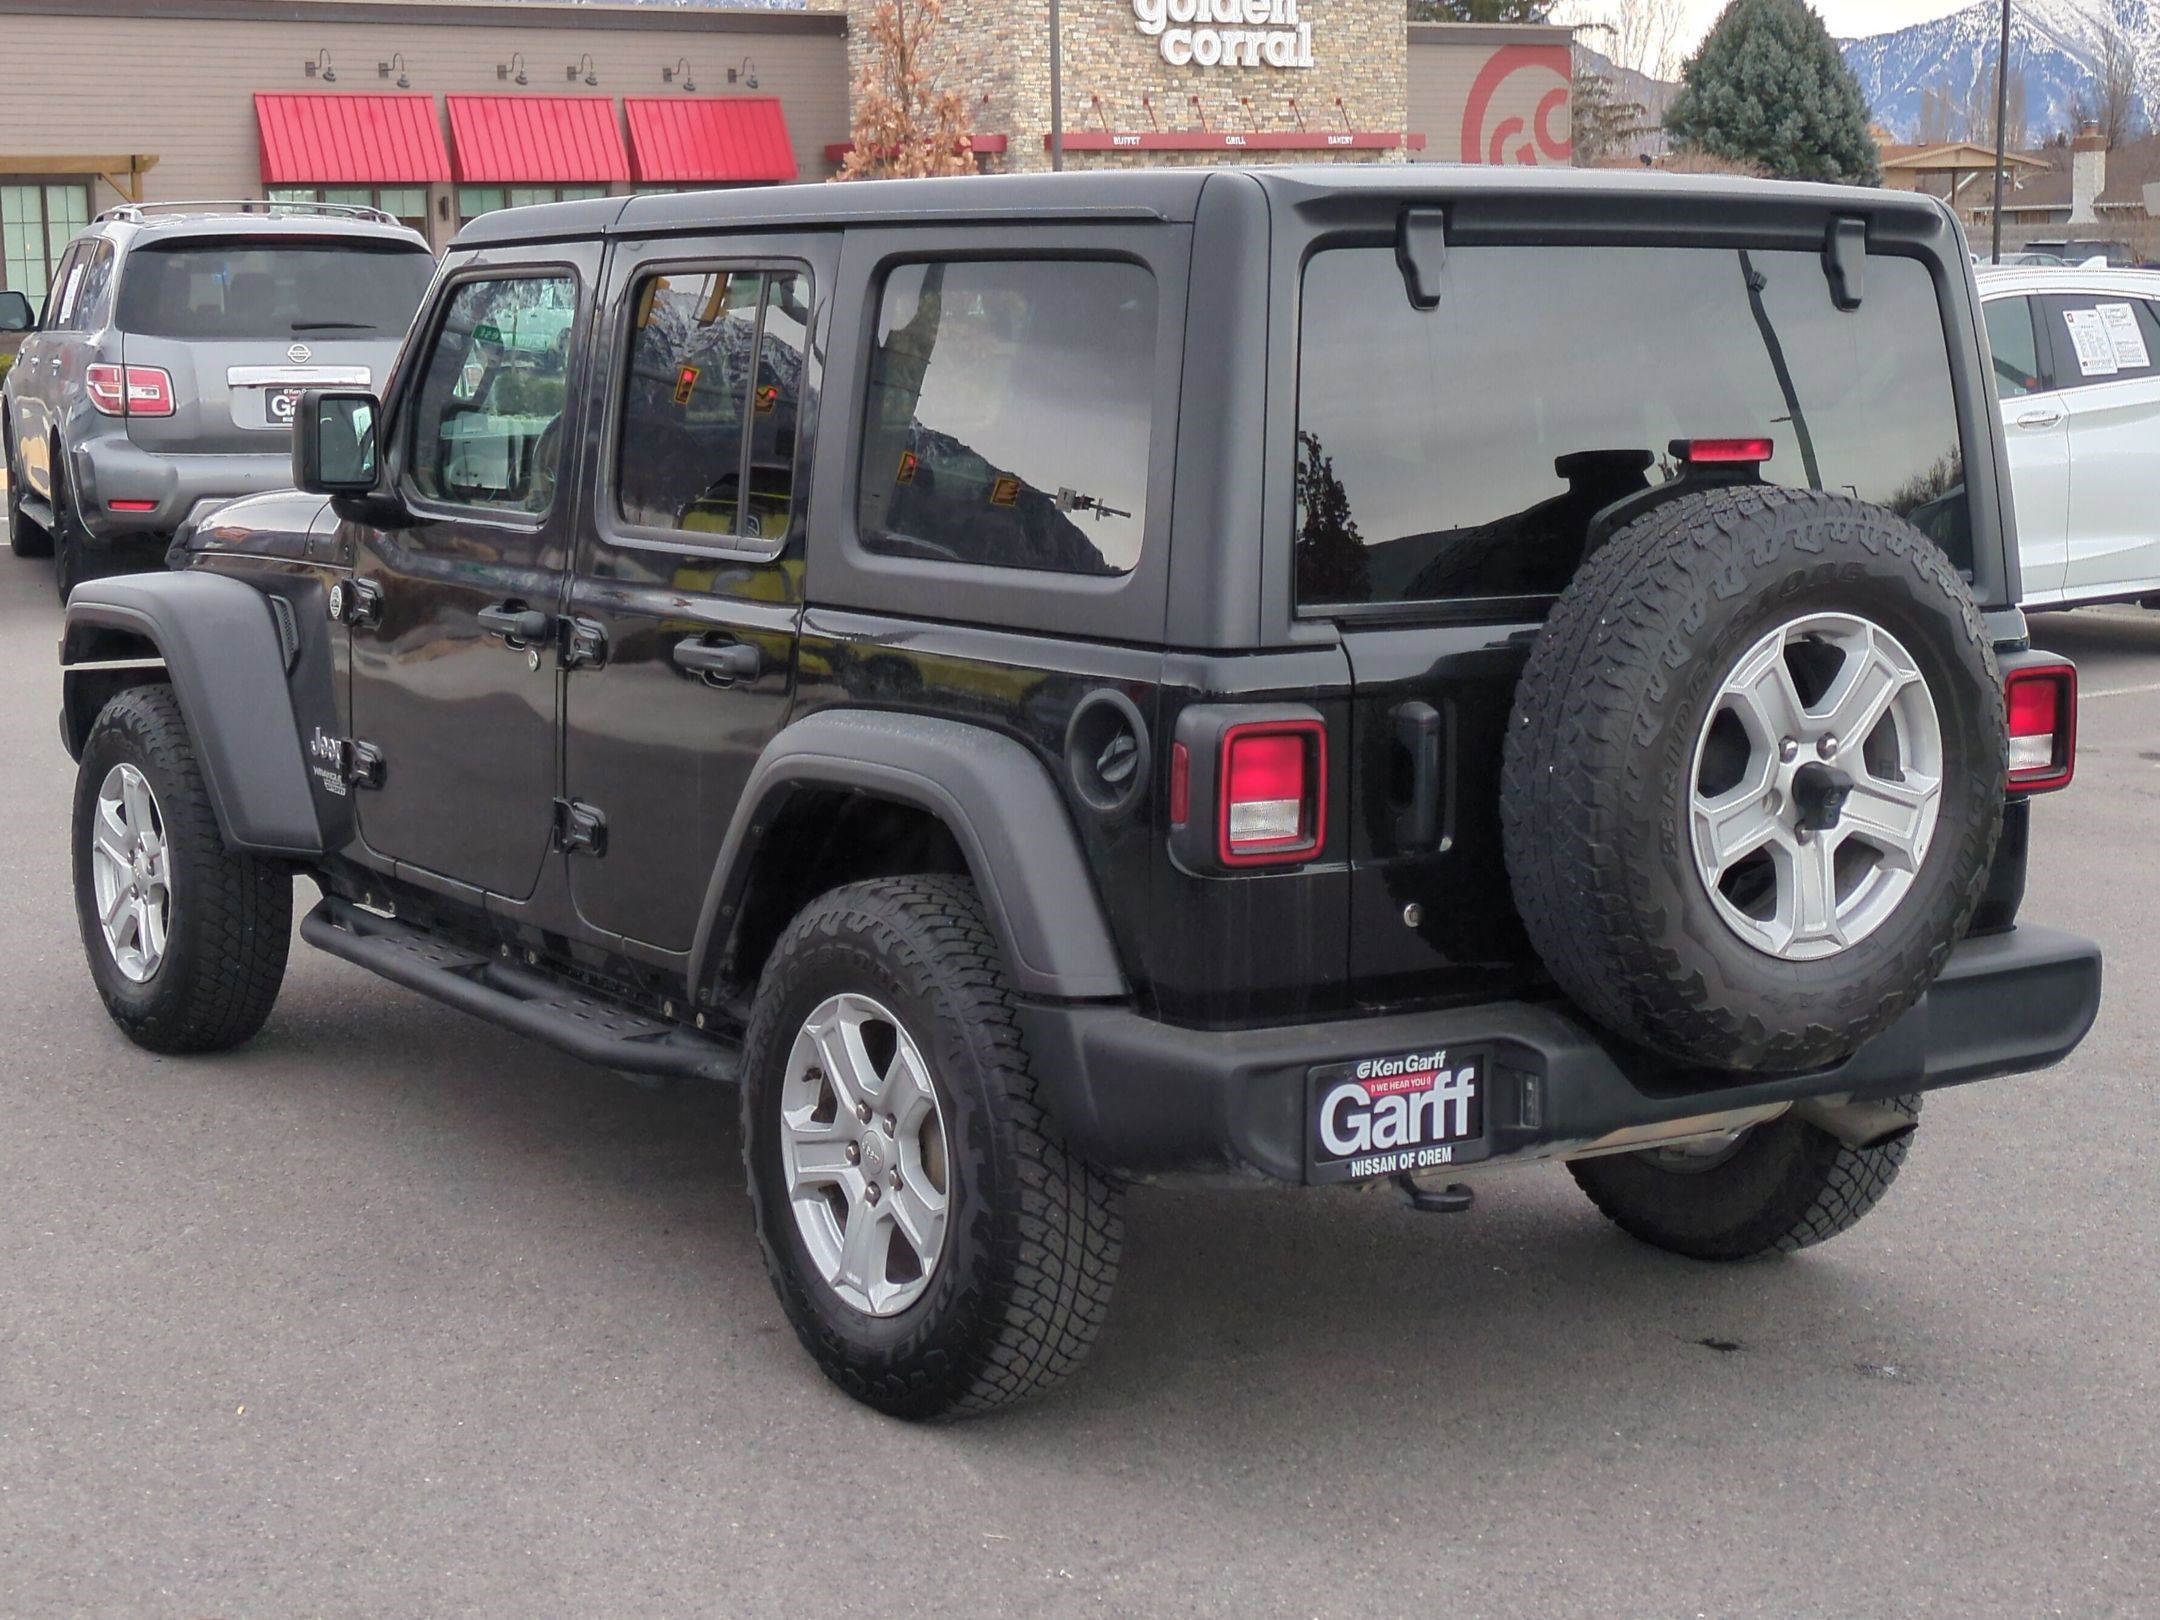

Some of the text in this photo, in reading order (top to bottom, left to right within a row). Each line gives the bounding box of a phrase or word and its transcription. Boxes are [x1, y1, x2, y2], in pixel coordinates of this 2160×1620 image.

[1160, 22, 1314, 67] corral
[1225, 135, 1246, 146] GRILL
[1371, 1050, 1446, 1078] Ken Garff
[1376, 1076, 1426, 1092] WE HEAR YOU
[1320, 1067, 1475, 1157] Garff
[1351, 1146, 1452, 1178] NISSAN OF OREM
